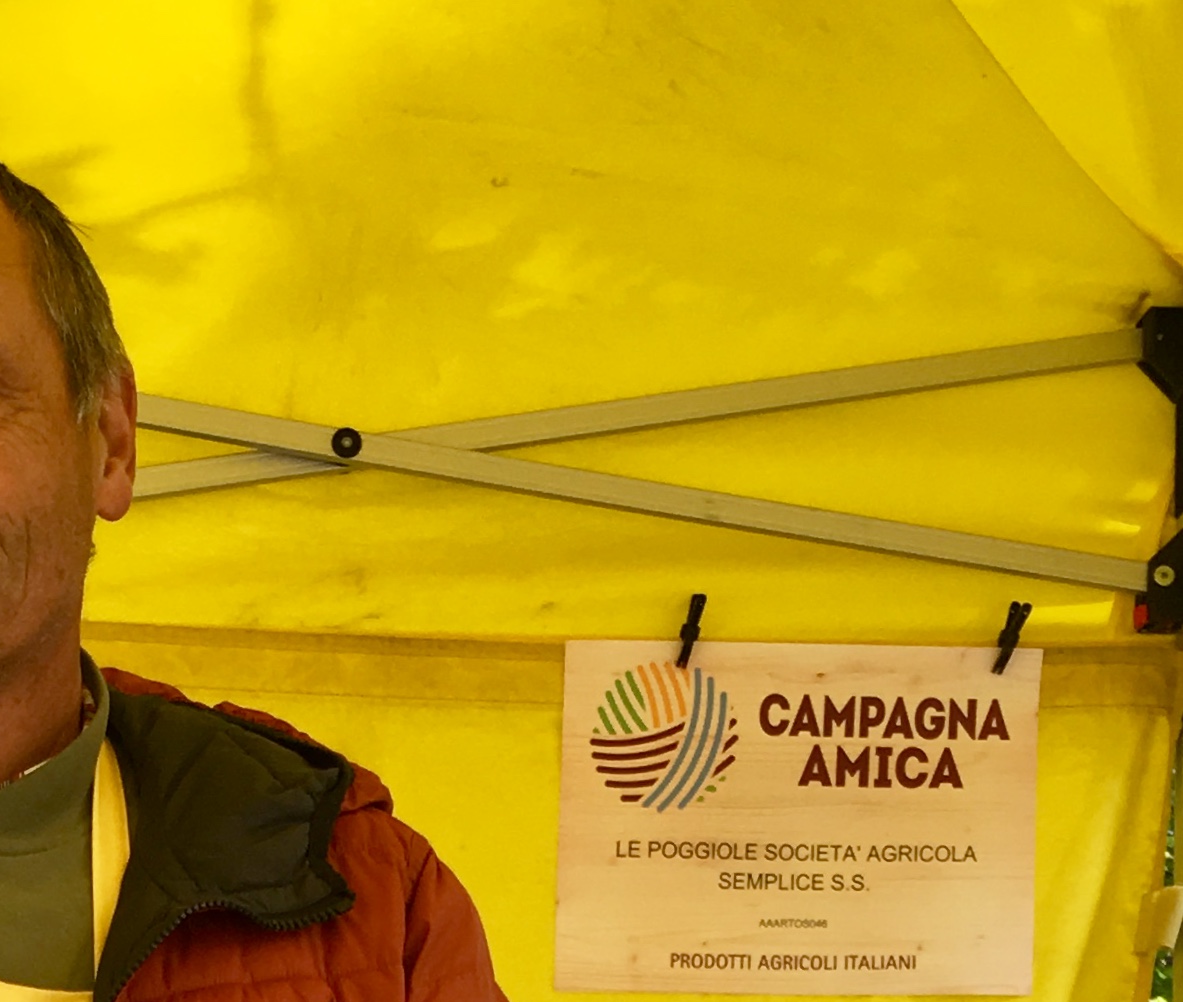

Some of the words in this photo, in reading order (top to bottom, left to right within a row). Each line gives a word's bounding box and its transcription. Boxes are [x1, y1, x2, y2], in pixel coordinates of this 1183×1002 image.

[759, 694, 1011, 741] CAMPAGNA
[798, 744, 964, 789] AMICA
[615, 840, 641, 858] LE
[647, 841, 758, 861] POGGIOLE
[764, 842, 862, 863] SOCIETA'
[866, 844, 978, 863] AGRICOLA
[718, 872, 825, 892] SEMPLICE
[830, 874, 870, 892] S.S.
[670, 953, 752, 971] PRODOTTI
[757, 954, 838, 971] AGRICOLI
[843, 954, 917, 971] ITALIANI
